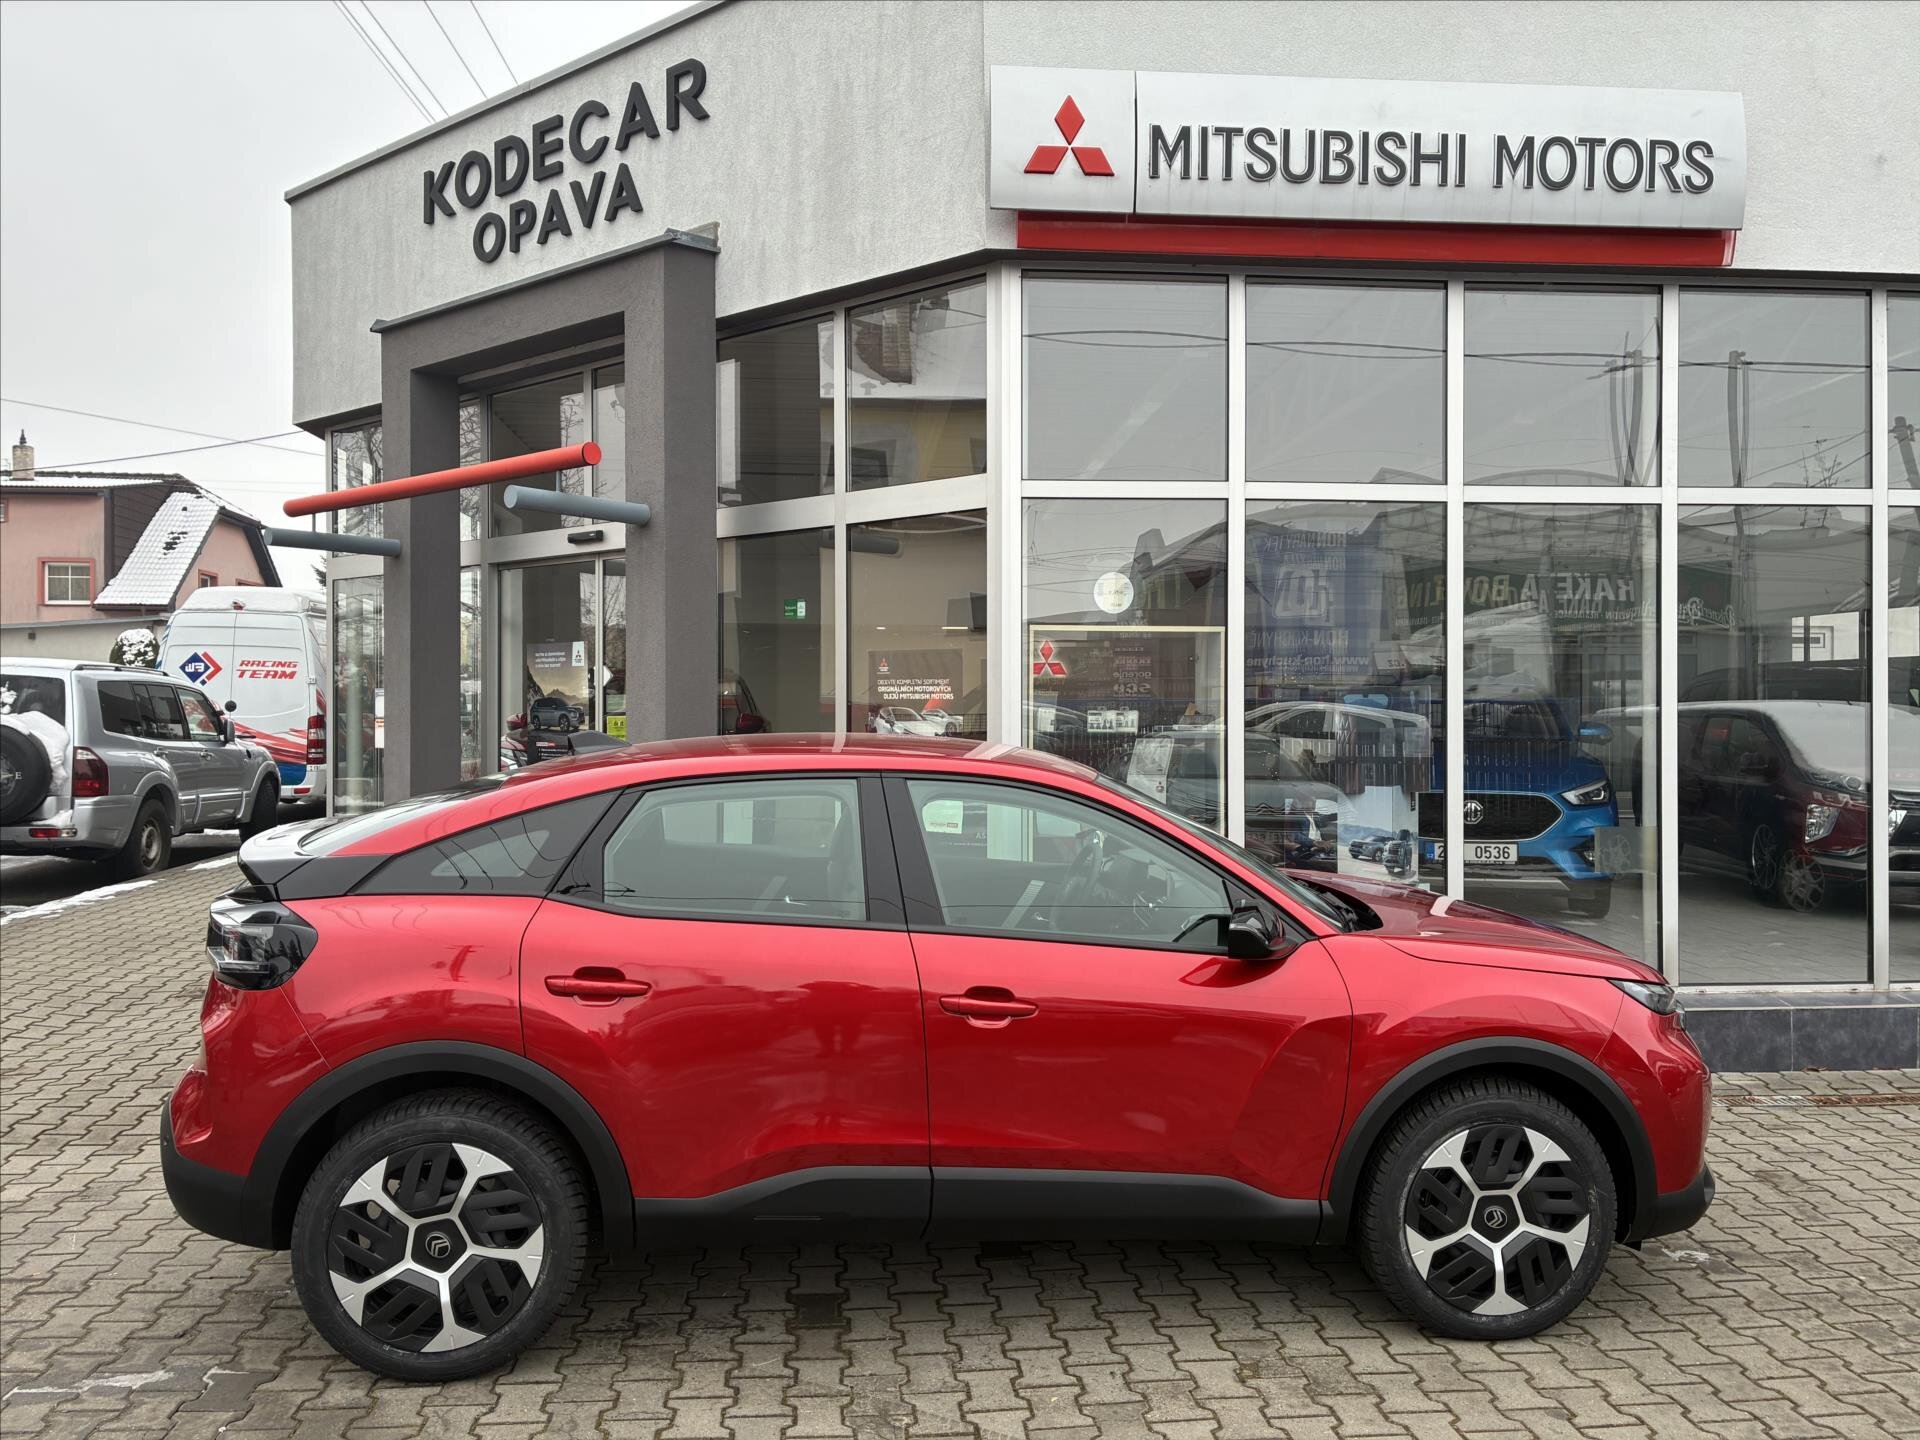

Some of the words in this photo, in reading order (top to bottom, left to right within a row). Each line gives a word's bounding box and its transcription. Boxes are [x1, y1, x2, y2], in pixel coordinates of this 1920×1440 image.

[423, 58, 710, 224] KODECAR
[1148, 123, 1466, 187] MITSUBISHI
[1493, 133, 1715, 194] MOTORS
[473, 162, 643, 263] OPAVA
[239, 660, 299, 668] RACING
[236, 669, 297, 680] TEAM
[914, 684, 952, 692] MOTOROVÝCH
[1474, 846, 1511, 859] 0536
